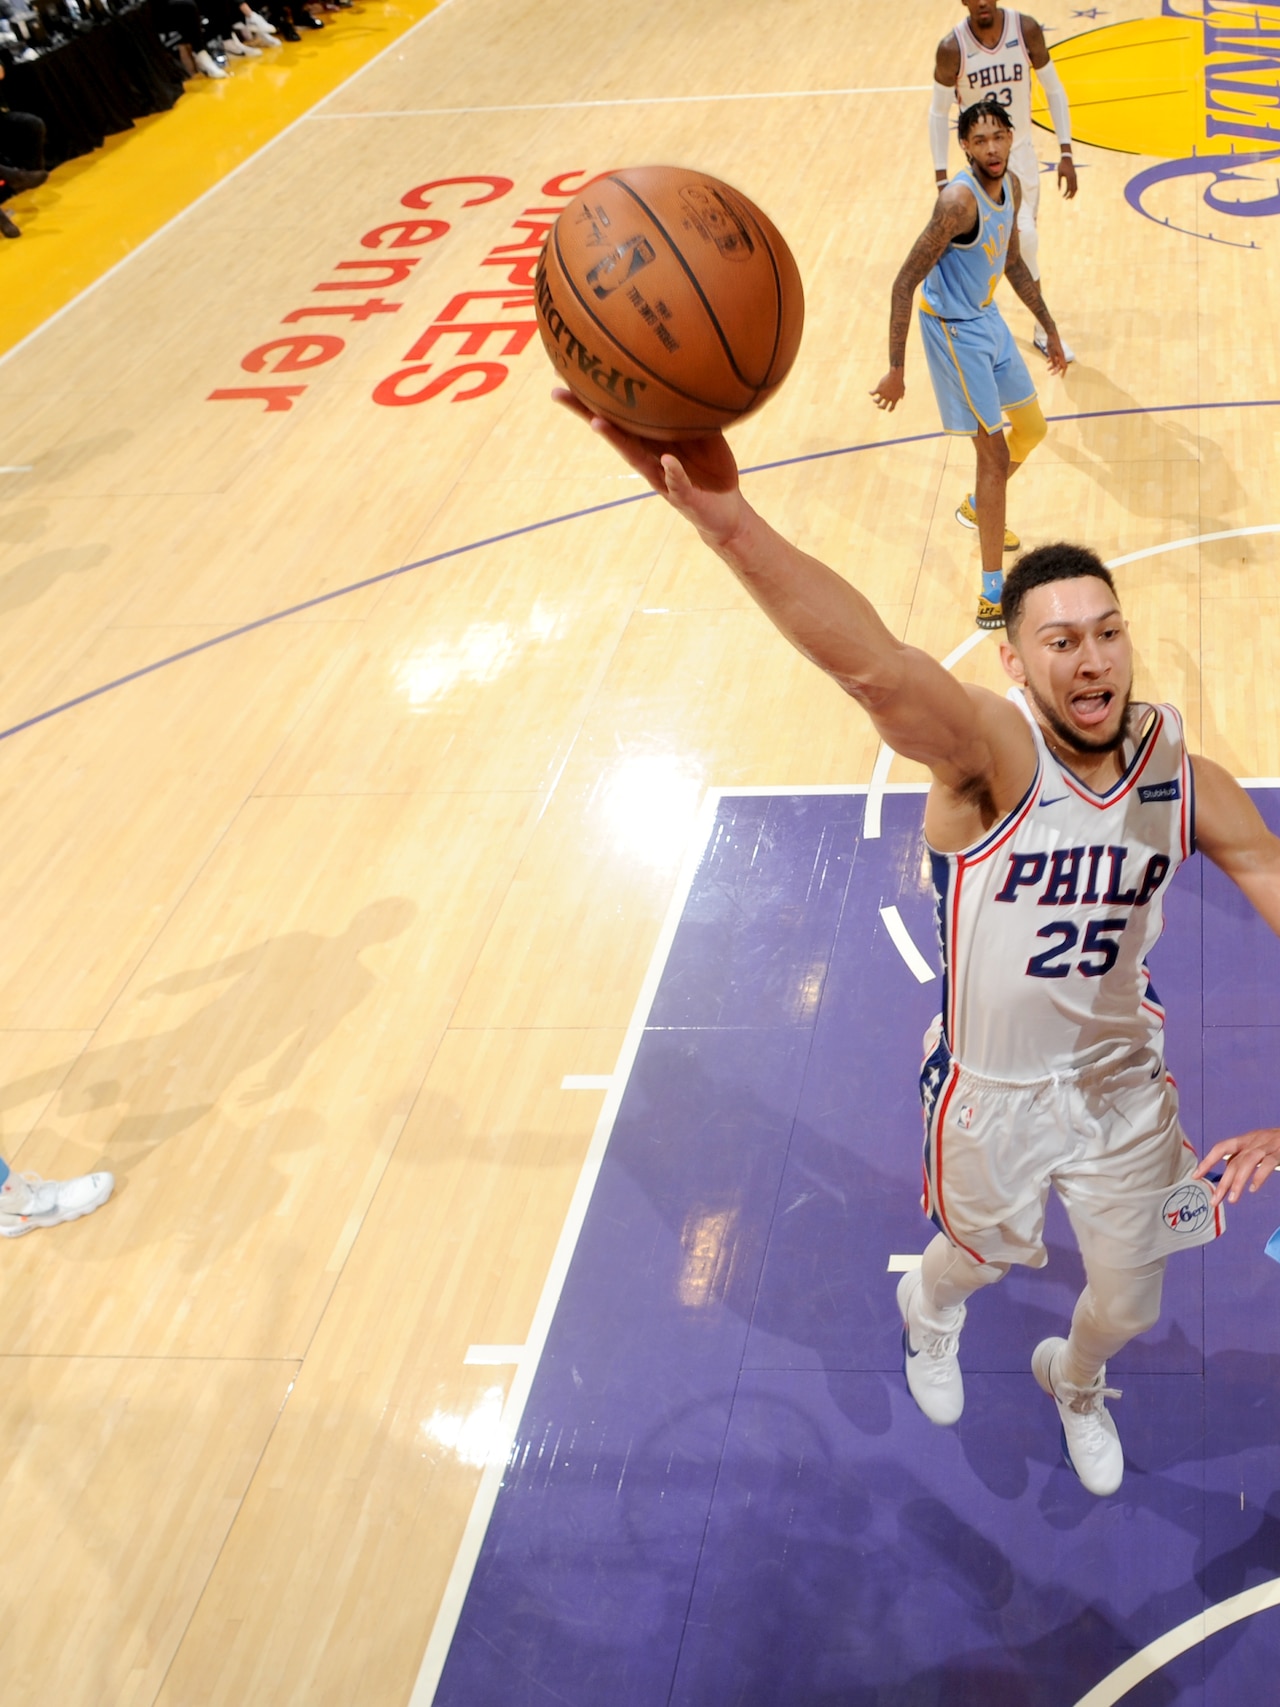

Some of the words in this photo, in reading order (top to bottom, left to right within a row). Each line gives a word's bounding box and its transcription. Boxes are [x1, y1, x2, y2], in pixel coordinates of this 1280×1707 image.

[204, 175, 514, 413] Center
[371, 168, 622, 407] SAPLES
[1025, 918, 1129, 978] 25
[1167, 1203, 1208, 1227] 76ers
